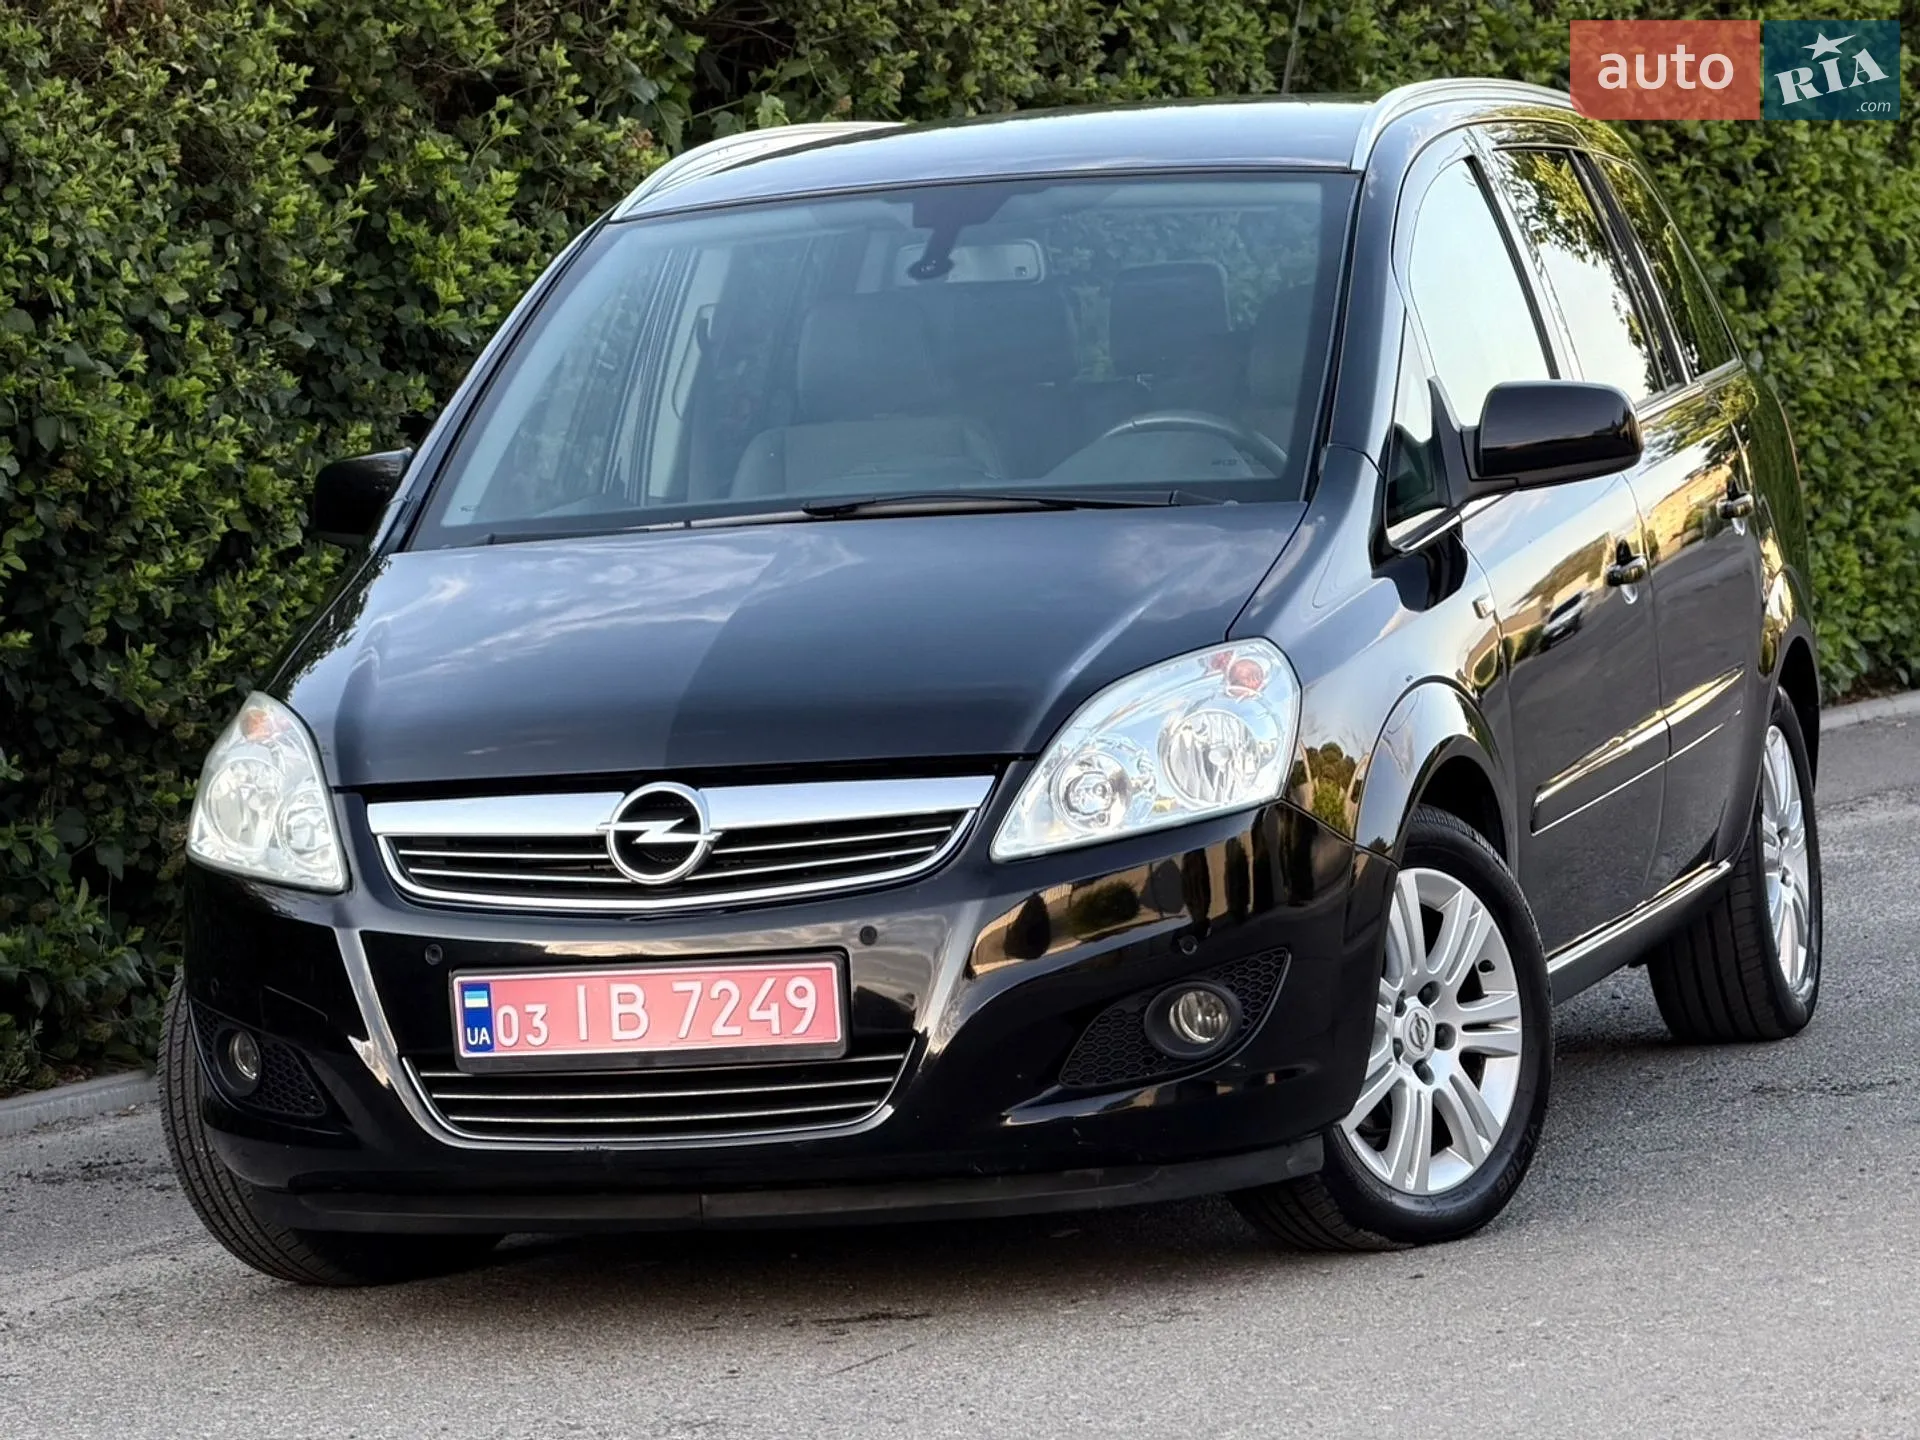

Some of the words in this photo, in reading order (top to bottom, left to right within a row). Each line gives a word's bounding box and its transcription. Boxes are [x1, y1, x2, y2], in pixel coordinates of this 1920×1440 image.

[496, 1004, 550, 1048] 03
[671, 976, 818, 1039] 7249
[466, 1027, 491, 1046] UA
